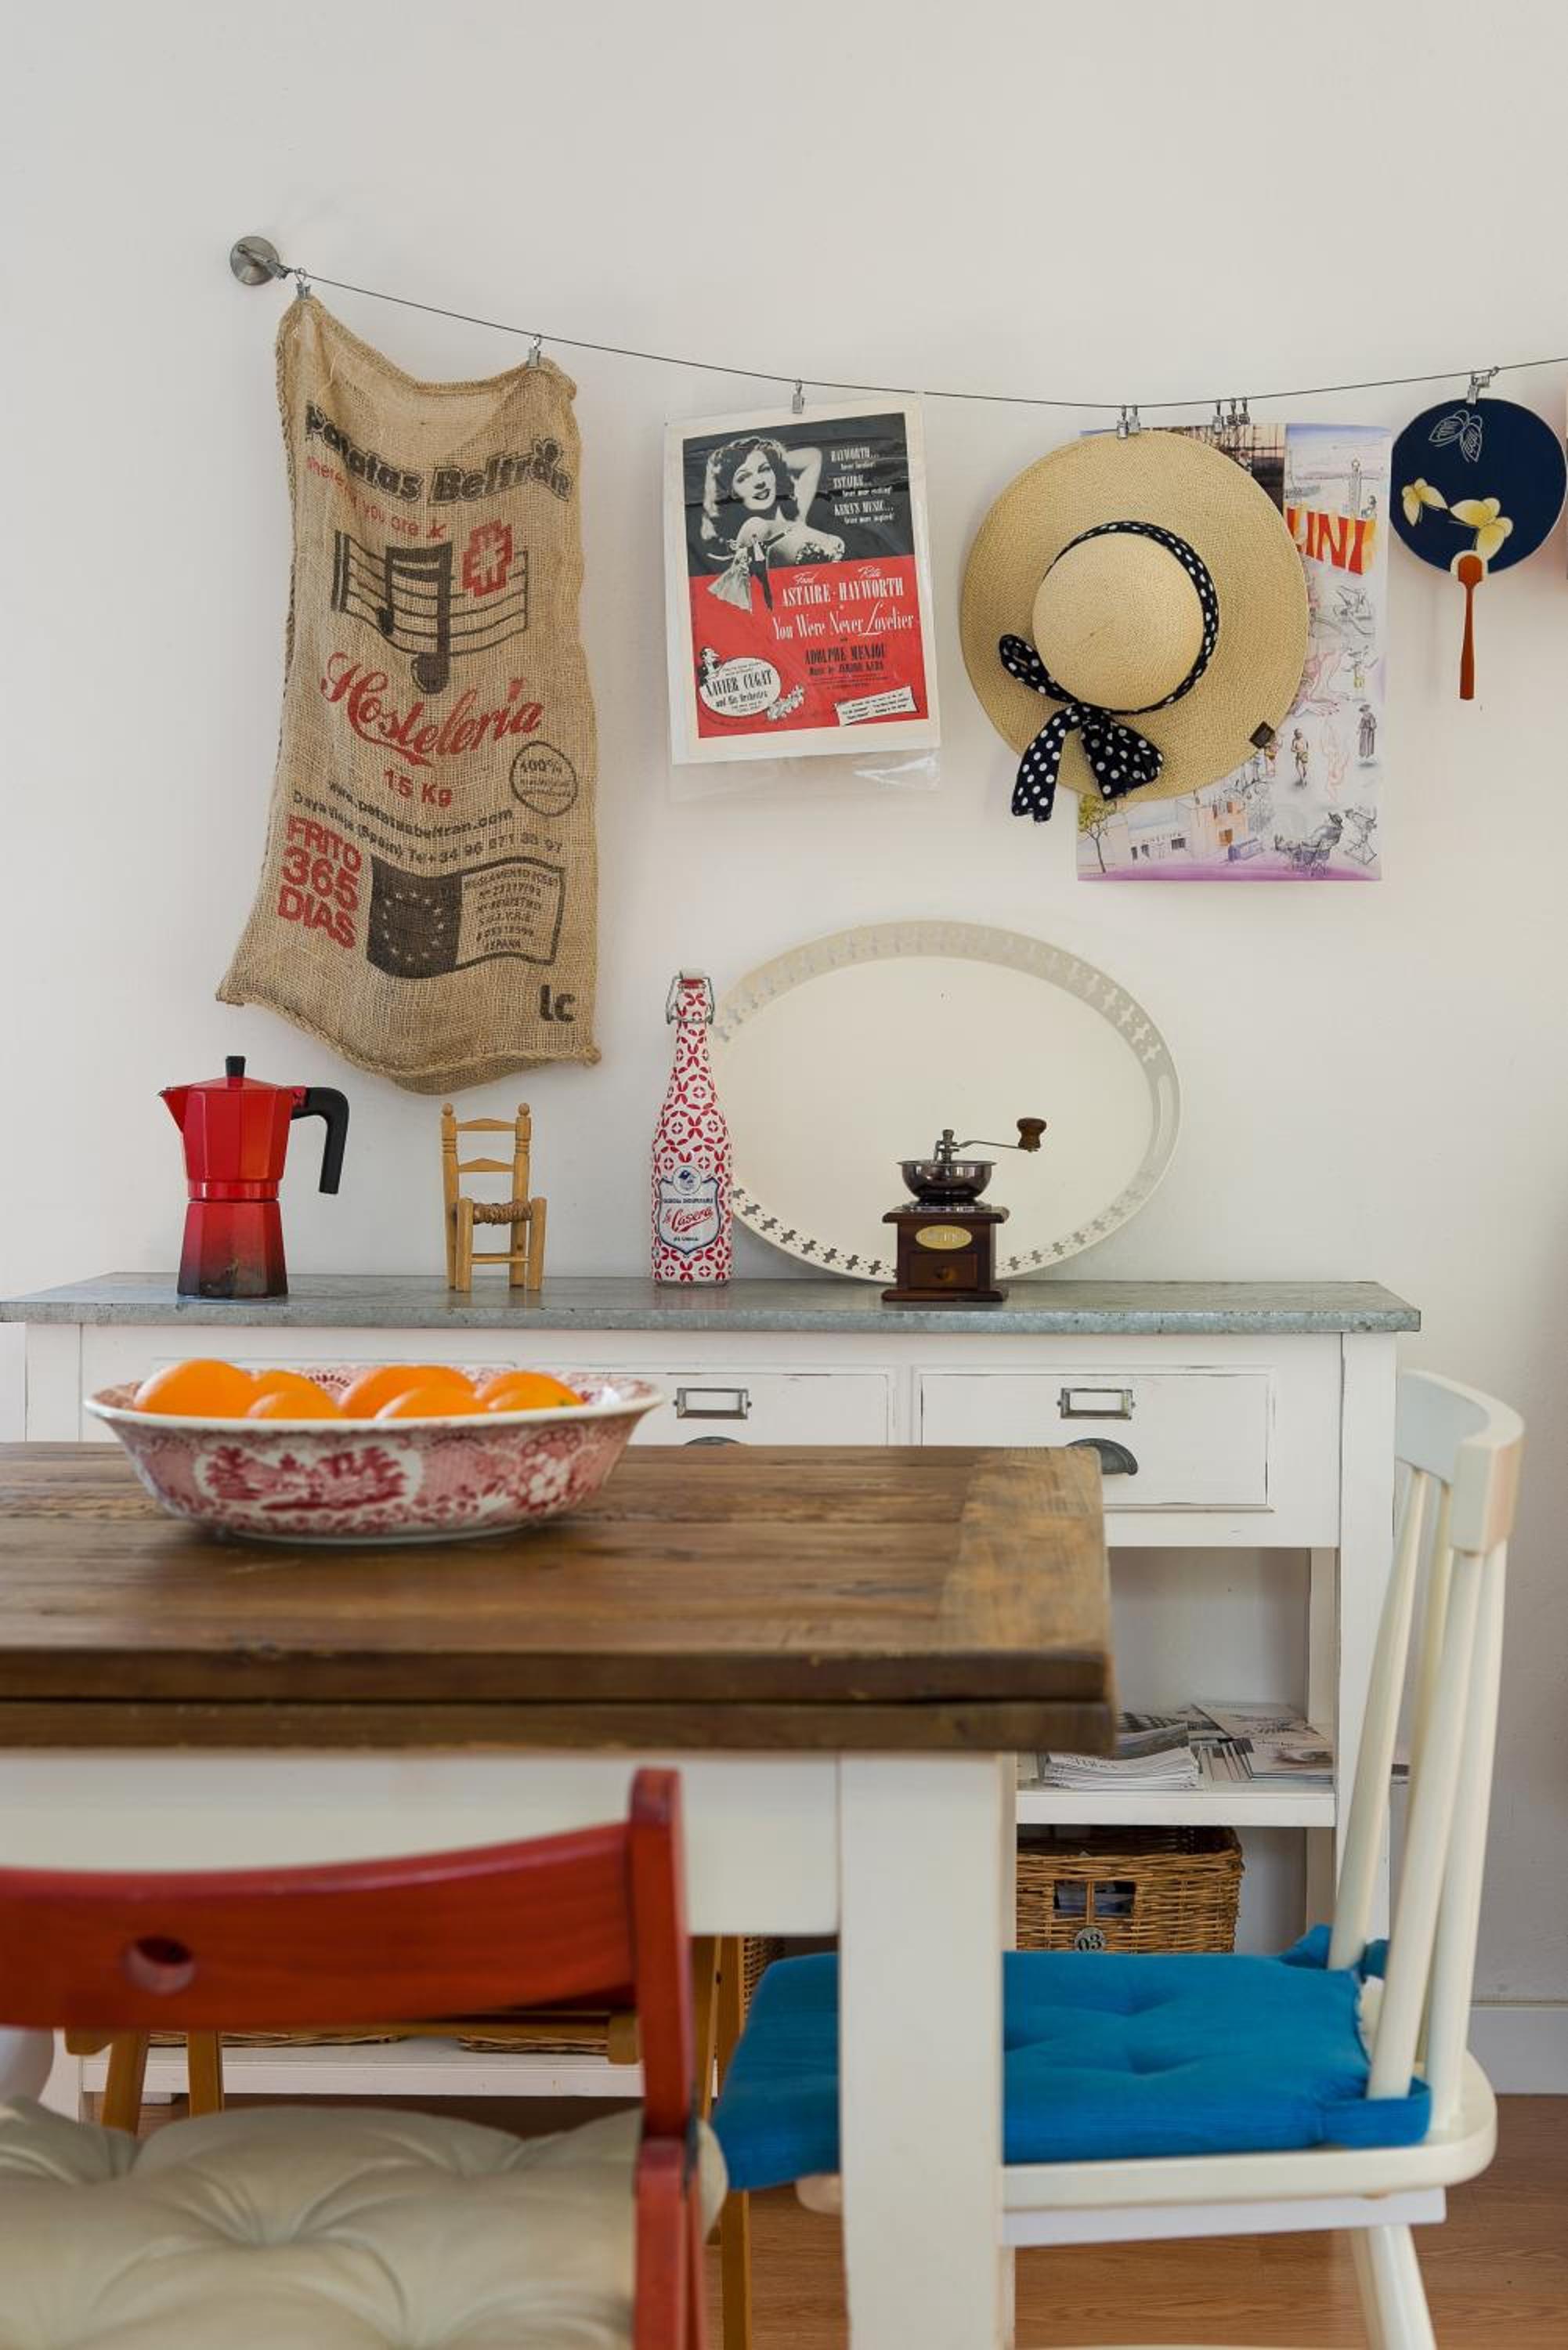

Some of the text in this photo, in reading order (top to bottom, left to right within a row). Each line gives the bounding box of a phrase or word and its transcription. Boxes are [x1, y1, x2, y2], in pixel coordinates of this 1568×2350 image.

[782, 576, 904, 608] ASTAIRE HAYWORTH
[772, 600, 915, 641] You Were Never Lovelier
[383, 767, 414, 799] 15
[286, 814, 363, 874] FRITO
[281, 846, 359, 913] 365
